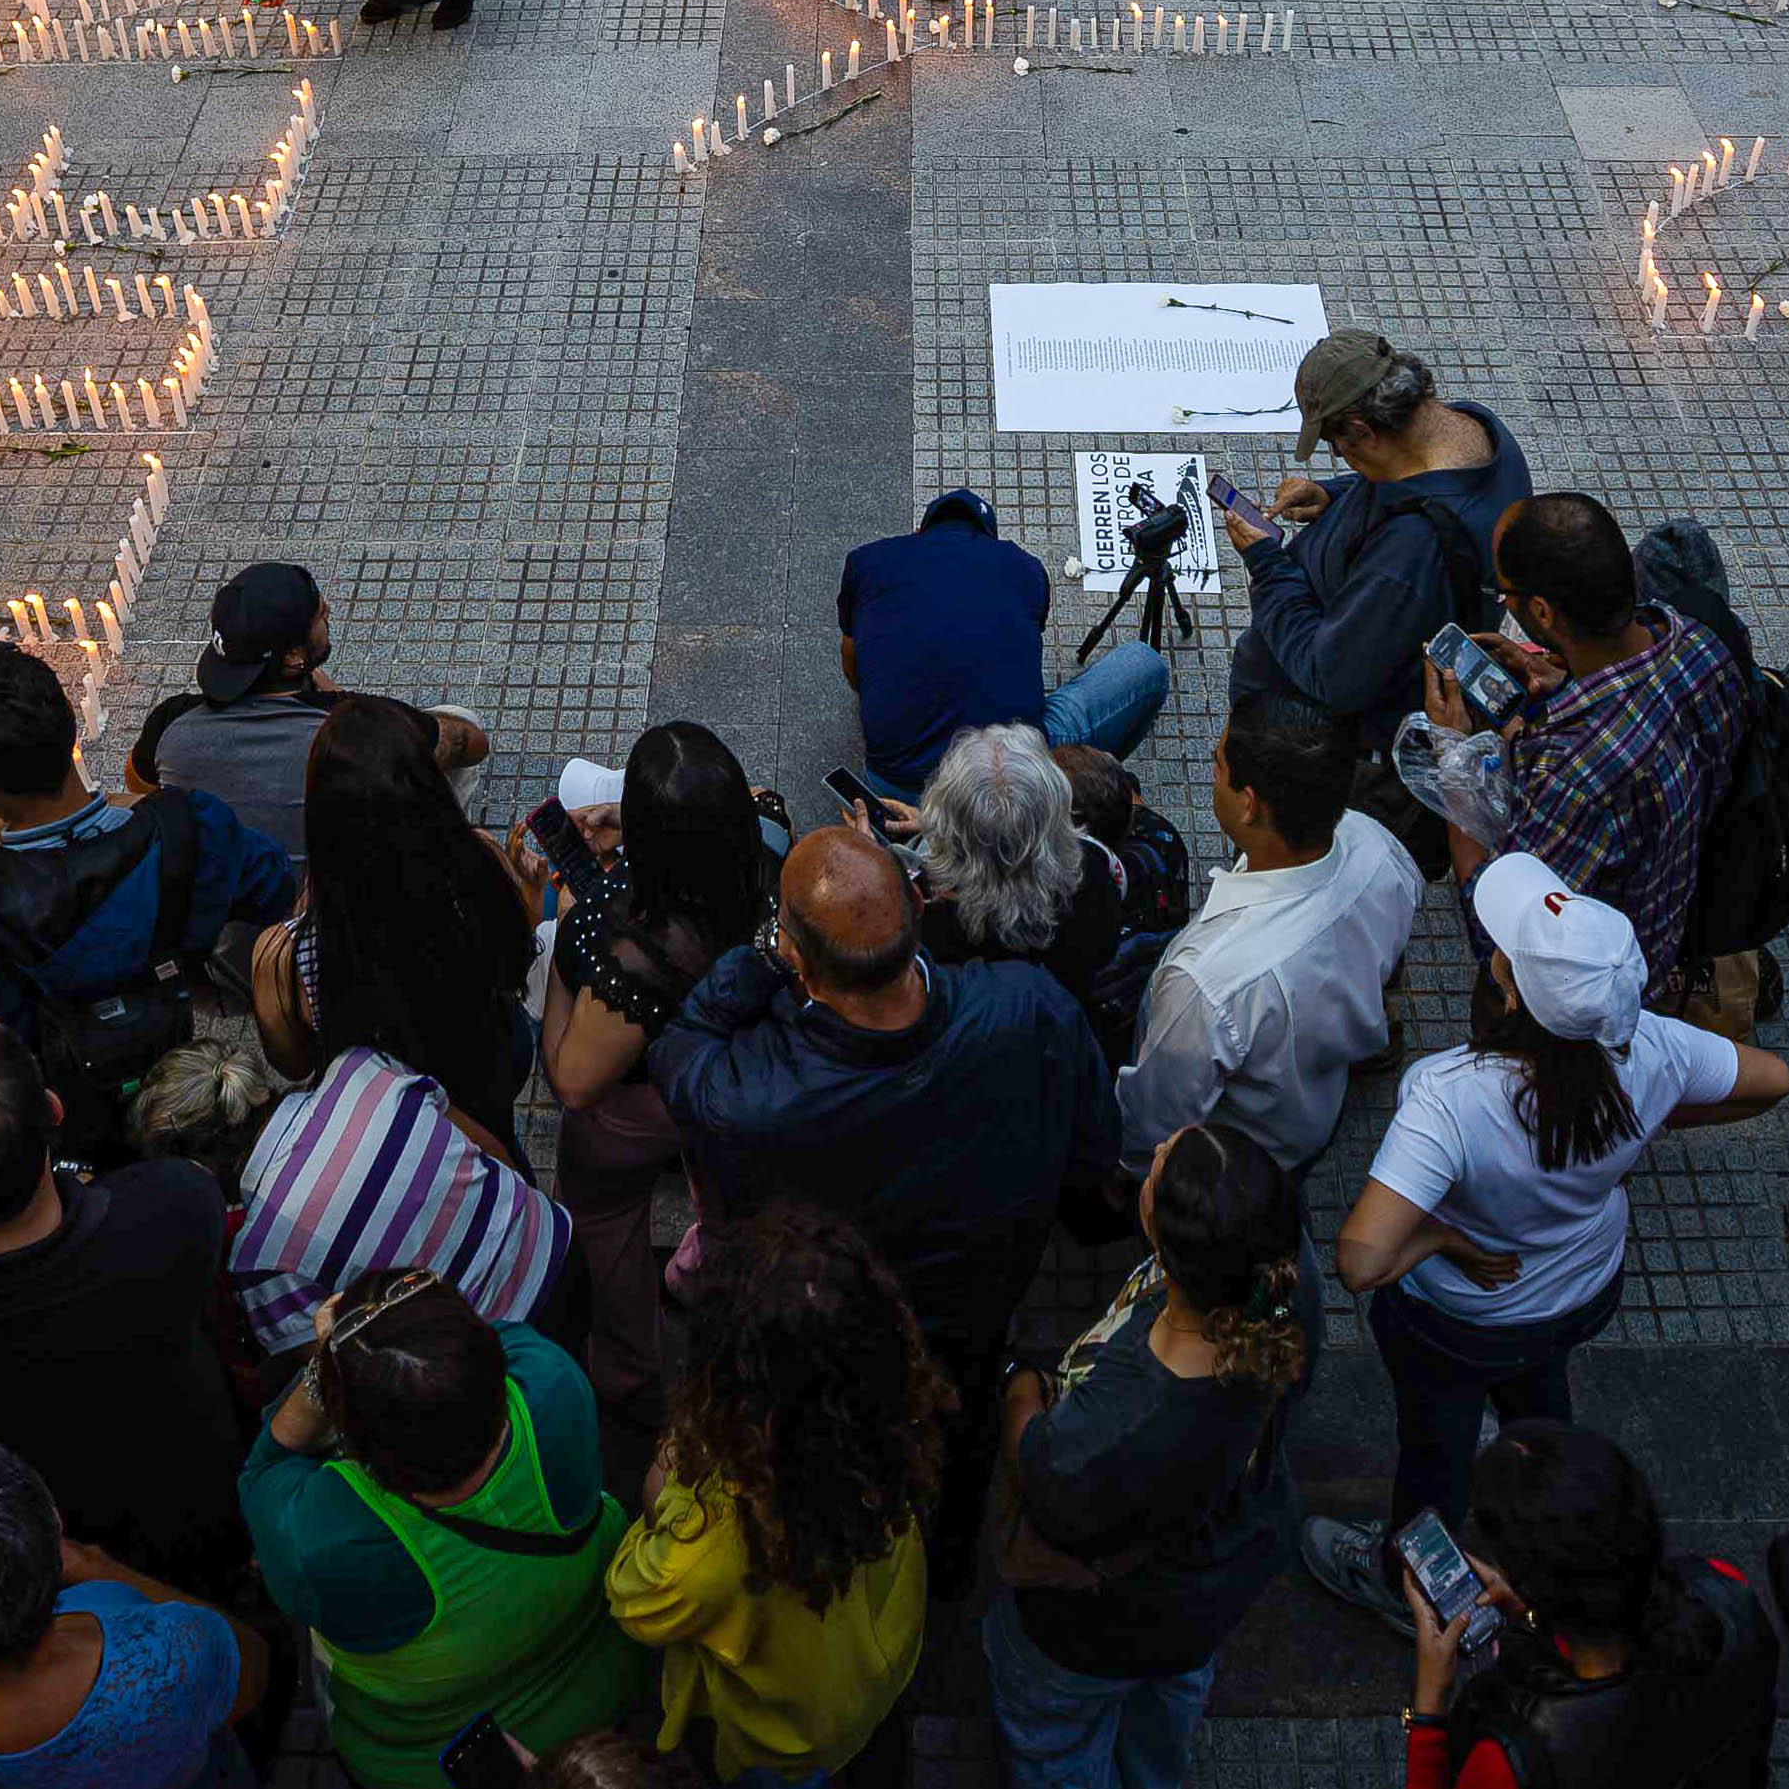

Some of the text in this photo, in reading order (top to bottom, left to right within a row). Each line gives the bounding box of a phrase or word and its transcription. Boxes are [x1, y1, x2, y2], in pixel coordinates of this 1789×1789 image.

[1114, 456, 1130, 479] DE
[1091, 453, 1115, 570] CIERREN LOS
